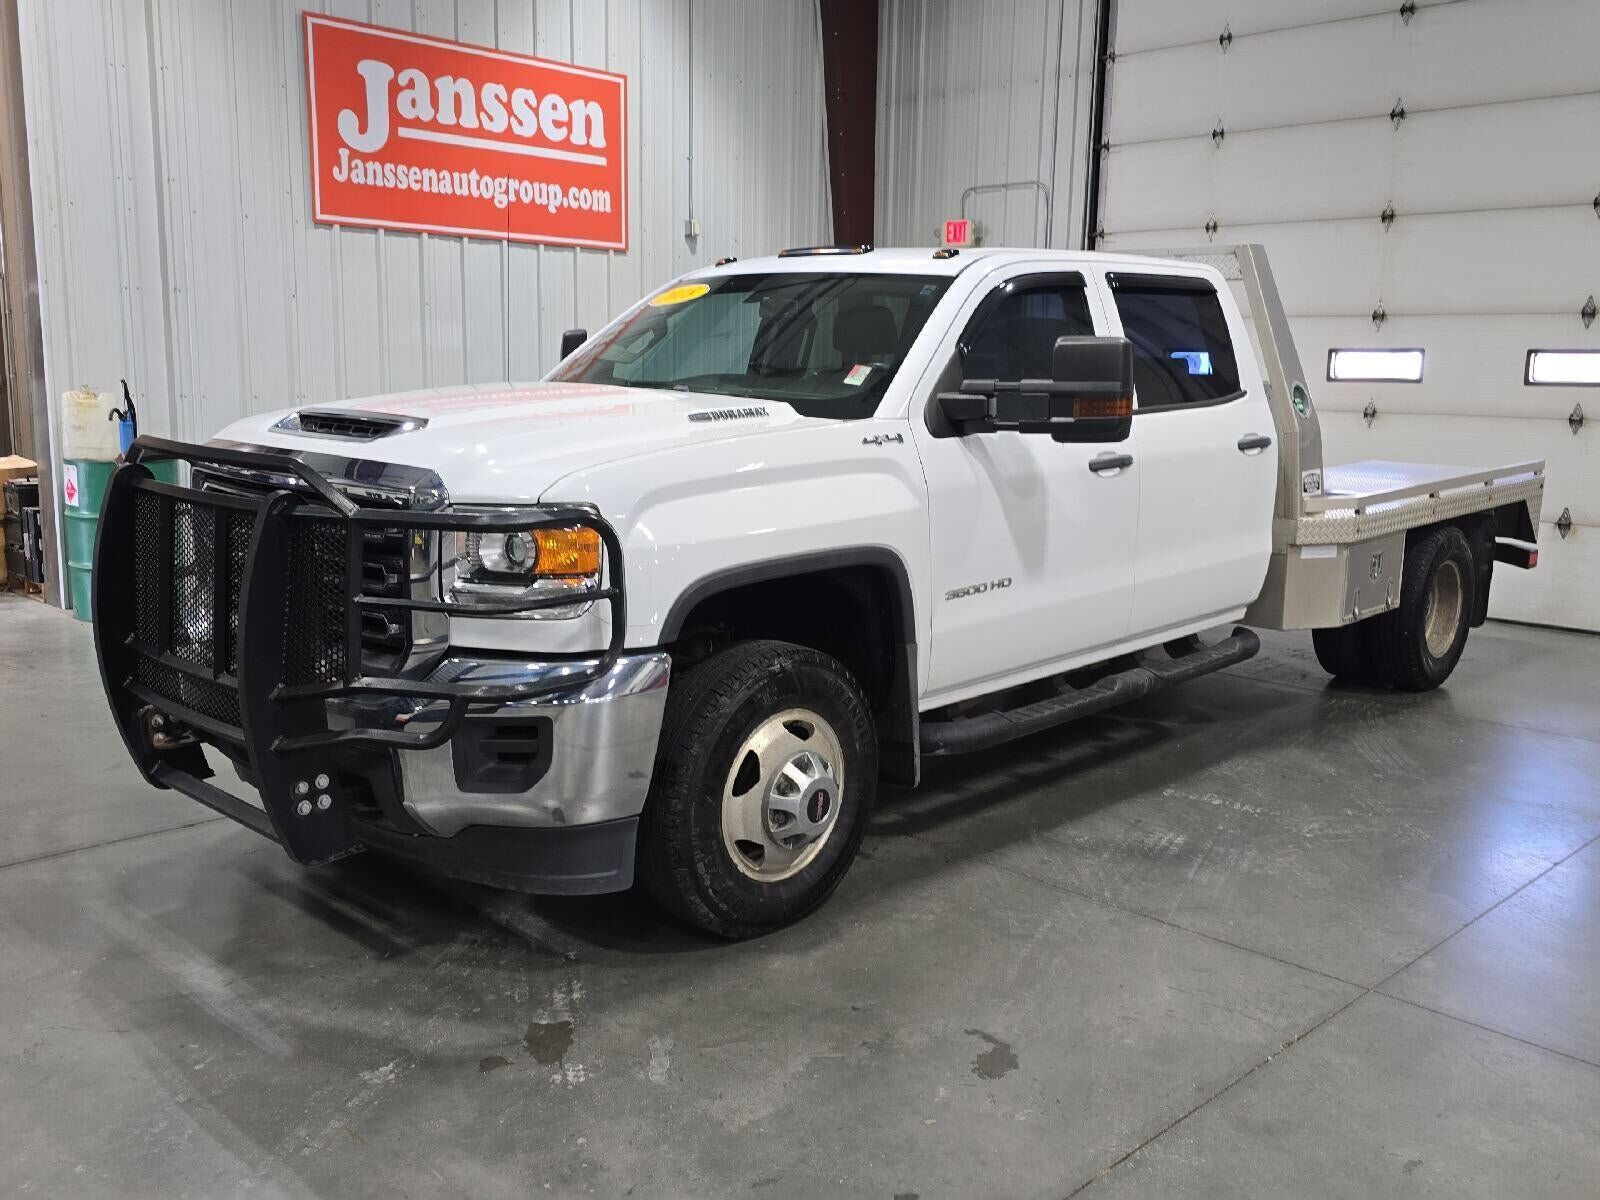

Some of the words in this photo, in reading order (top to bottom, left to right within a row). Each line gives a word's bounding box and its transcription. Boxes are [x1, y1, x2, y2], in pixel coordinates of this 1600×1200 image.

[337, 59, 607, 153] Janssen
[332, 148, 612, 214] Janssenautogroup.com
[947, 221, 967, 243] EXIT
[710, 406, 769, 421] DURAMAX
[944, 583, 988, 601] 3500
[990, 577, 1012, 591] HD
